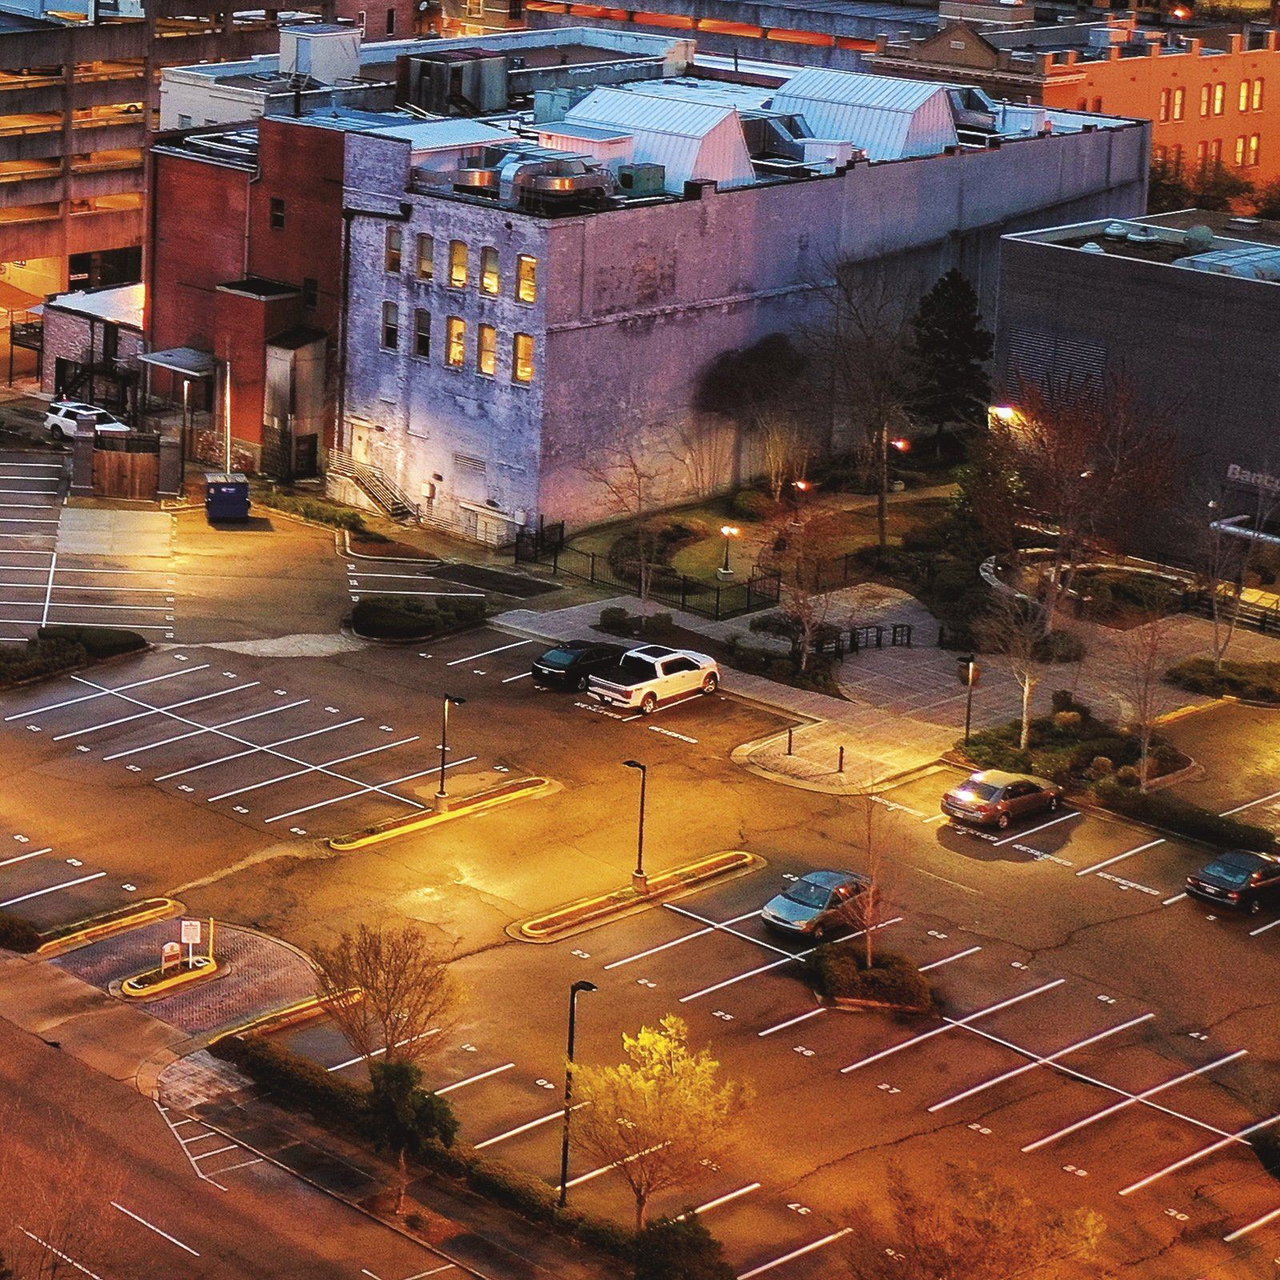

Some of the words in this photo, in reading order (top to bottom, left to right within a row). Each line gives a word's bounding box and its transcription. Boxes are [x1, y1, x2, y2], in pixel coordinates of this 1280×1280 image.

[711, 1010, 734, 1021] 25
[1188, 1032, 1209, 1041] 17
[793, 1045, 816, 1057] 26
[876, 1083, 902, 1094] 27
[786, 1202, 812, 1216] 37
[1163, 1208, 1190, 1221] 30
